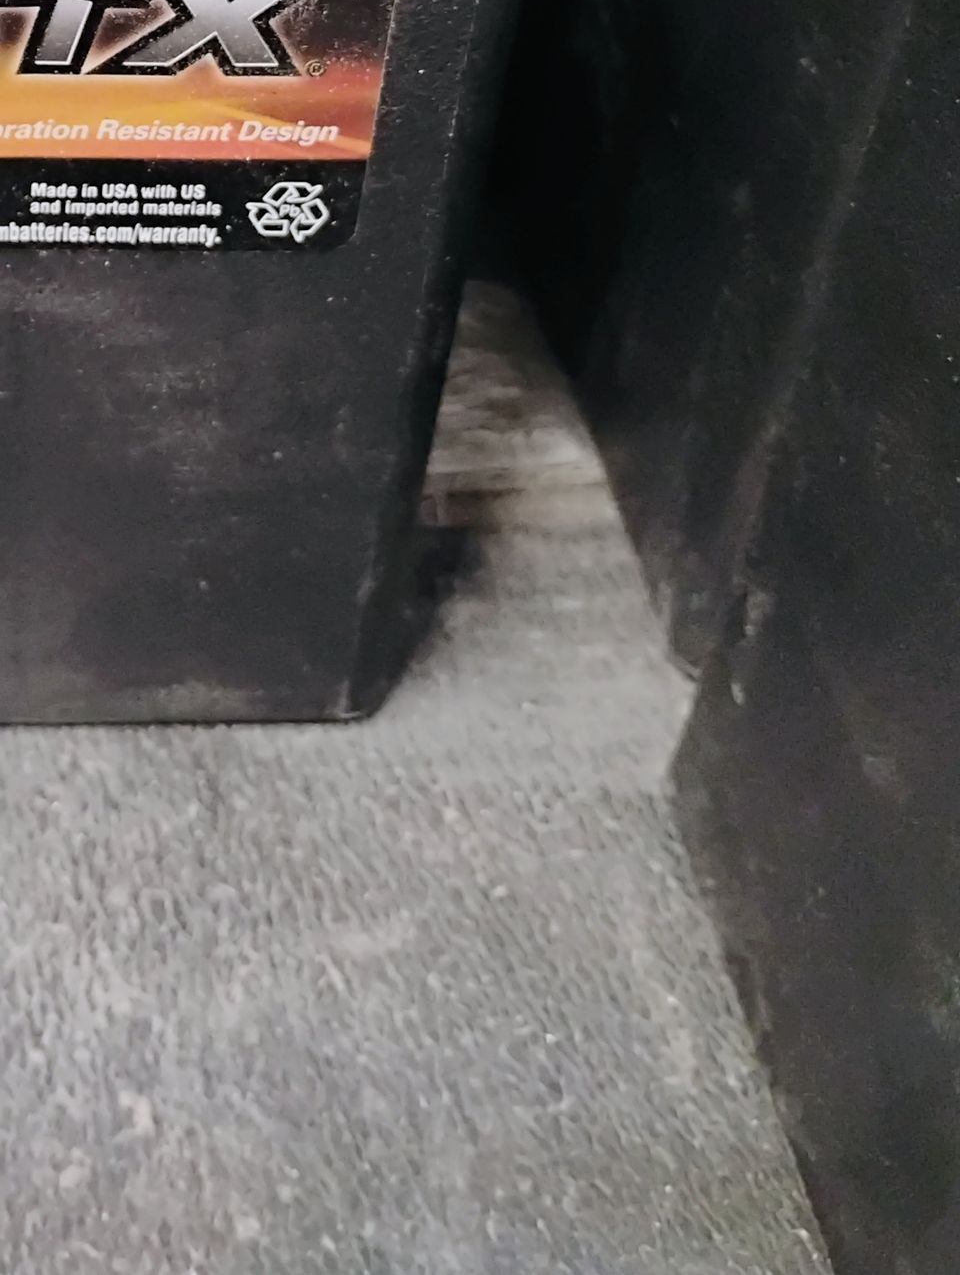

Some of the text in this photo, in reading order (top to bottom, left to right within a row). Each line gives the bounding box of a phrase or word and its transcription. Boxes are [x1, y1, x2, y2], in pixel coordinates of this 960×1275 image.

[97, 120, 230, 142] Resistant
[236, 121, 339, 145] Design
[30, 182, 206, 199] Made in USA with US
[29, 201, 222, 218] and imported materials
